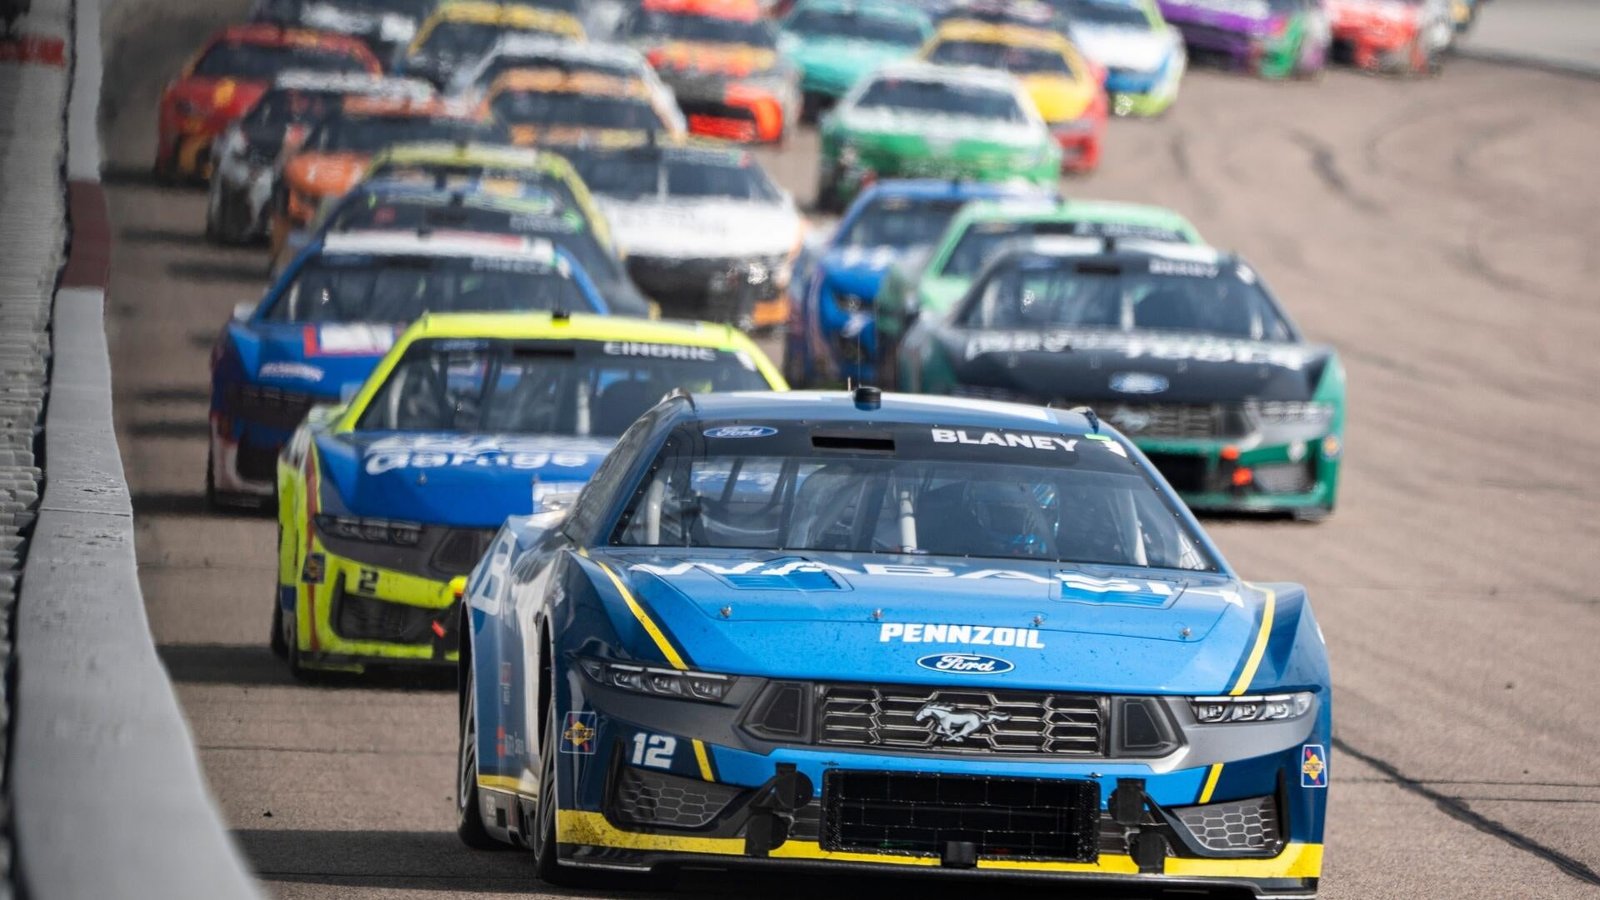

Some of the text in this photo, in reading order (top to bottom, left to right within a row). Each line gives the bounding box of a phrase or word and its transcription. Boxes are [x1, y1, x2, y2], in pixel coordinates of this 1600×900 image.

[931, 429, 1079, 452] BLANEY
[359, 567, 379, 593] 2
[879, 623, 1046, 649] PENNZOIL
[934, 653, 997, 674] Ford
[631, 731, 677, 769] 12
